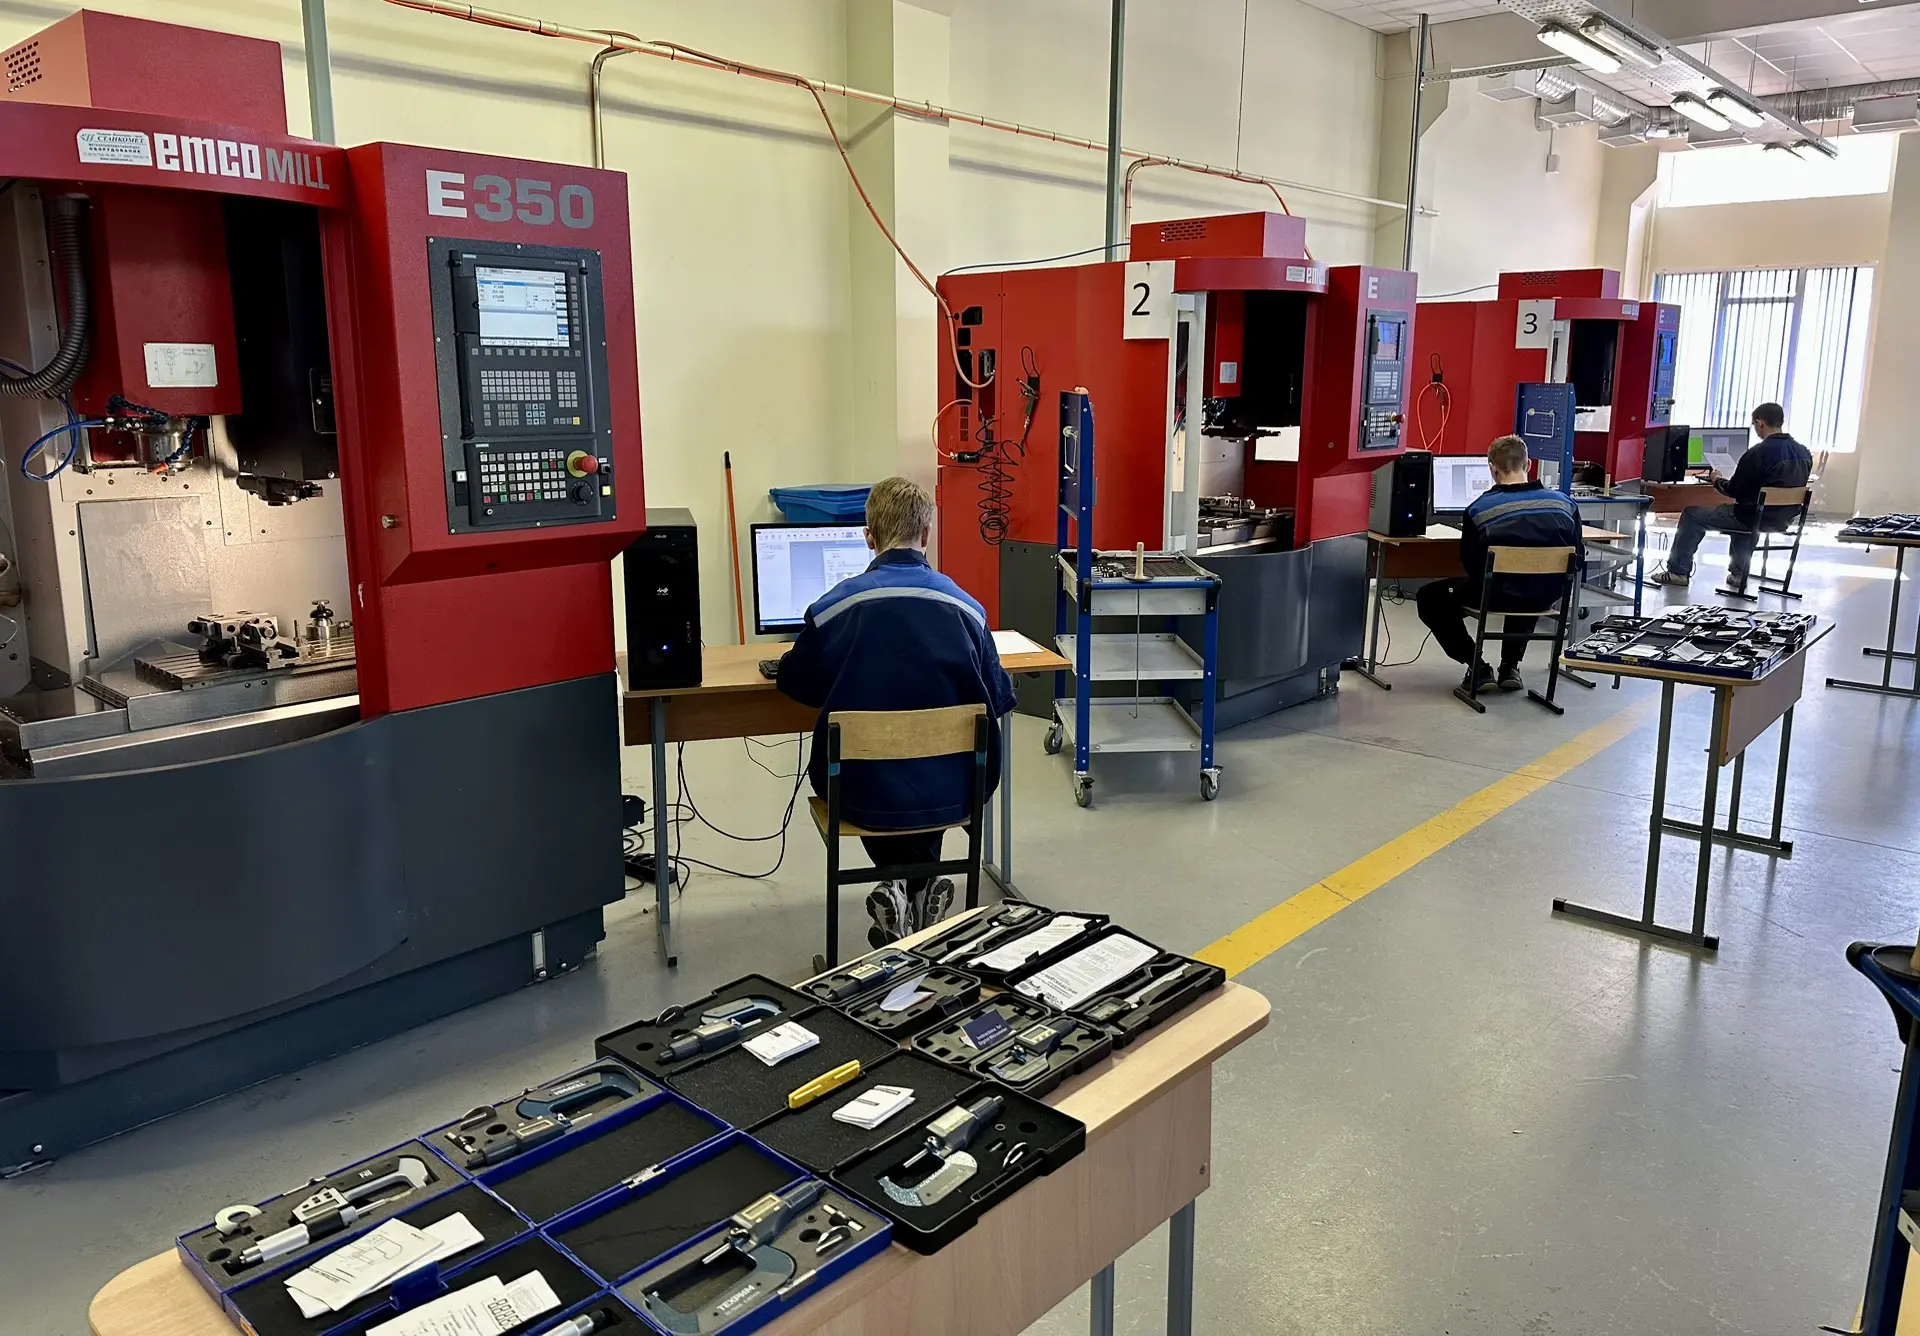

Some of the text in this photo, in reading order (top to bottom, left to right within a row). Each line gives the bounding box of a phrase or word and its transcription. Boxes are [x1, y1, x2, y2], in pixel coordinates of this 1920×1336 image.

[153, 132, 330, 190] emco MILL
[426, 169, 594, 229] E350
[1132, 282, 1150, 316] 2
[1523, 313, 1538, 334] 3
